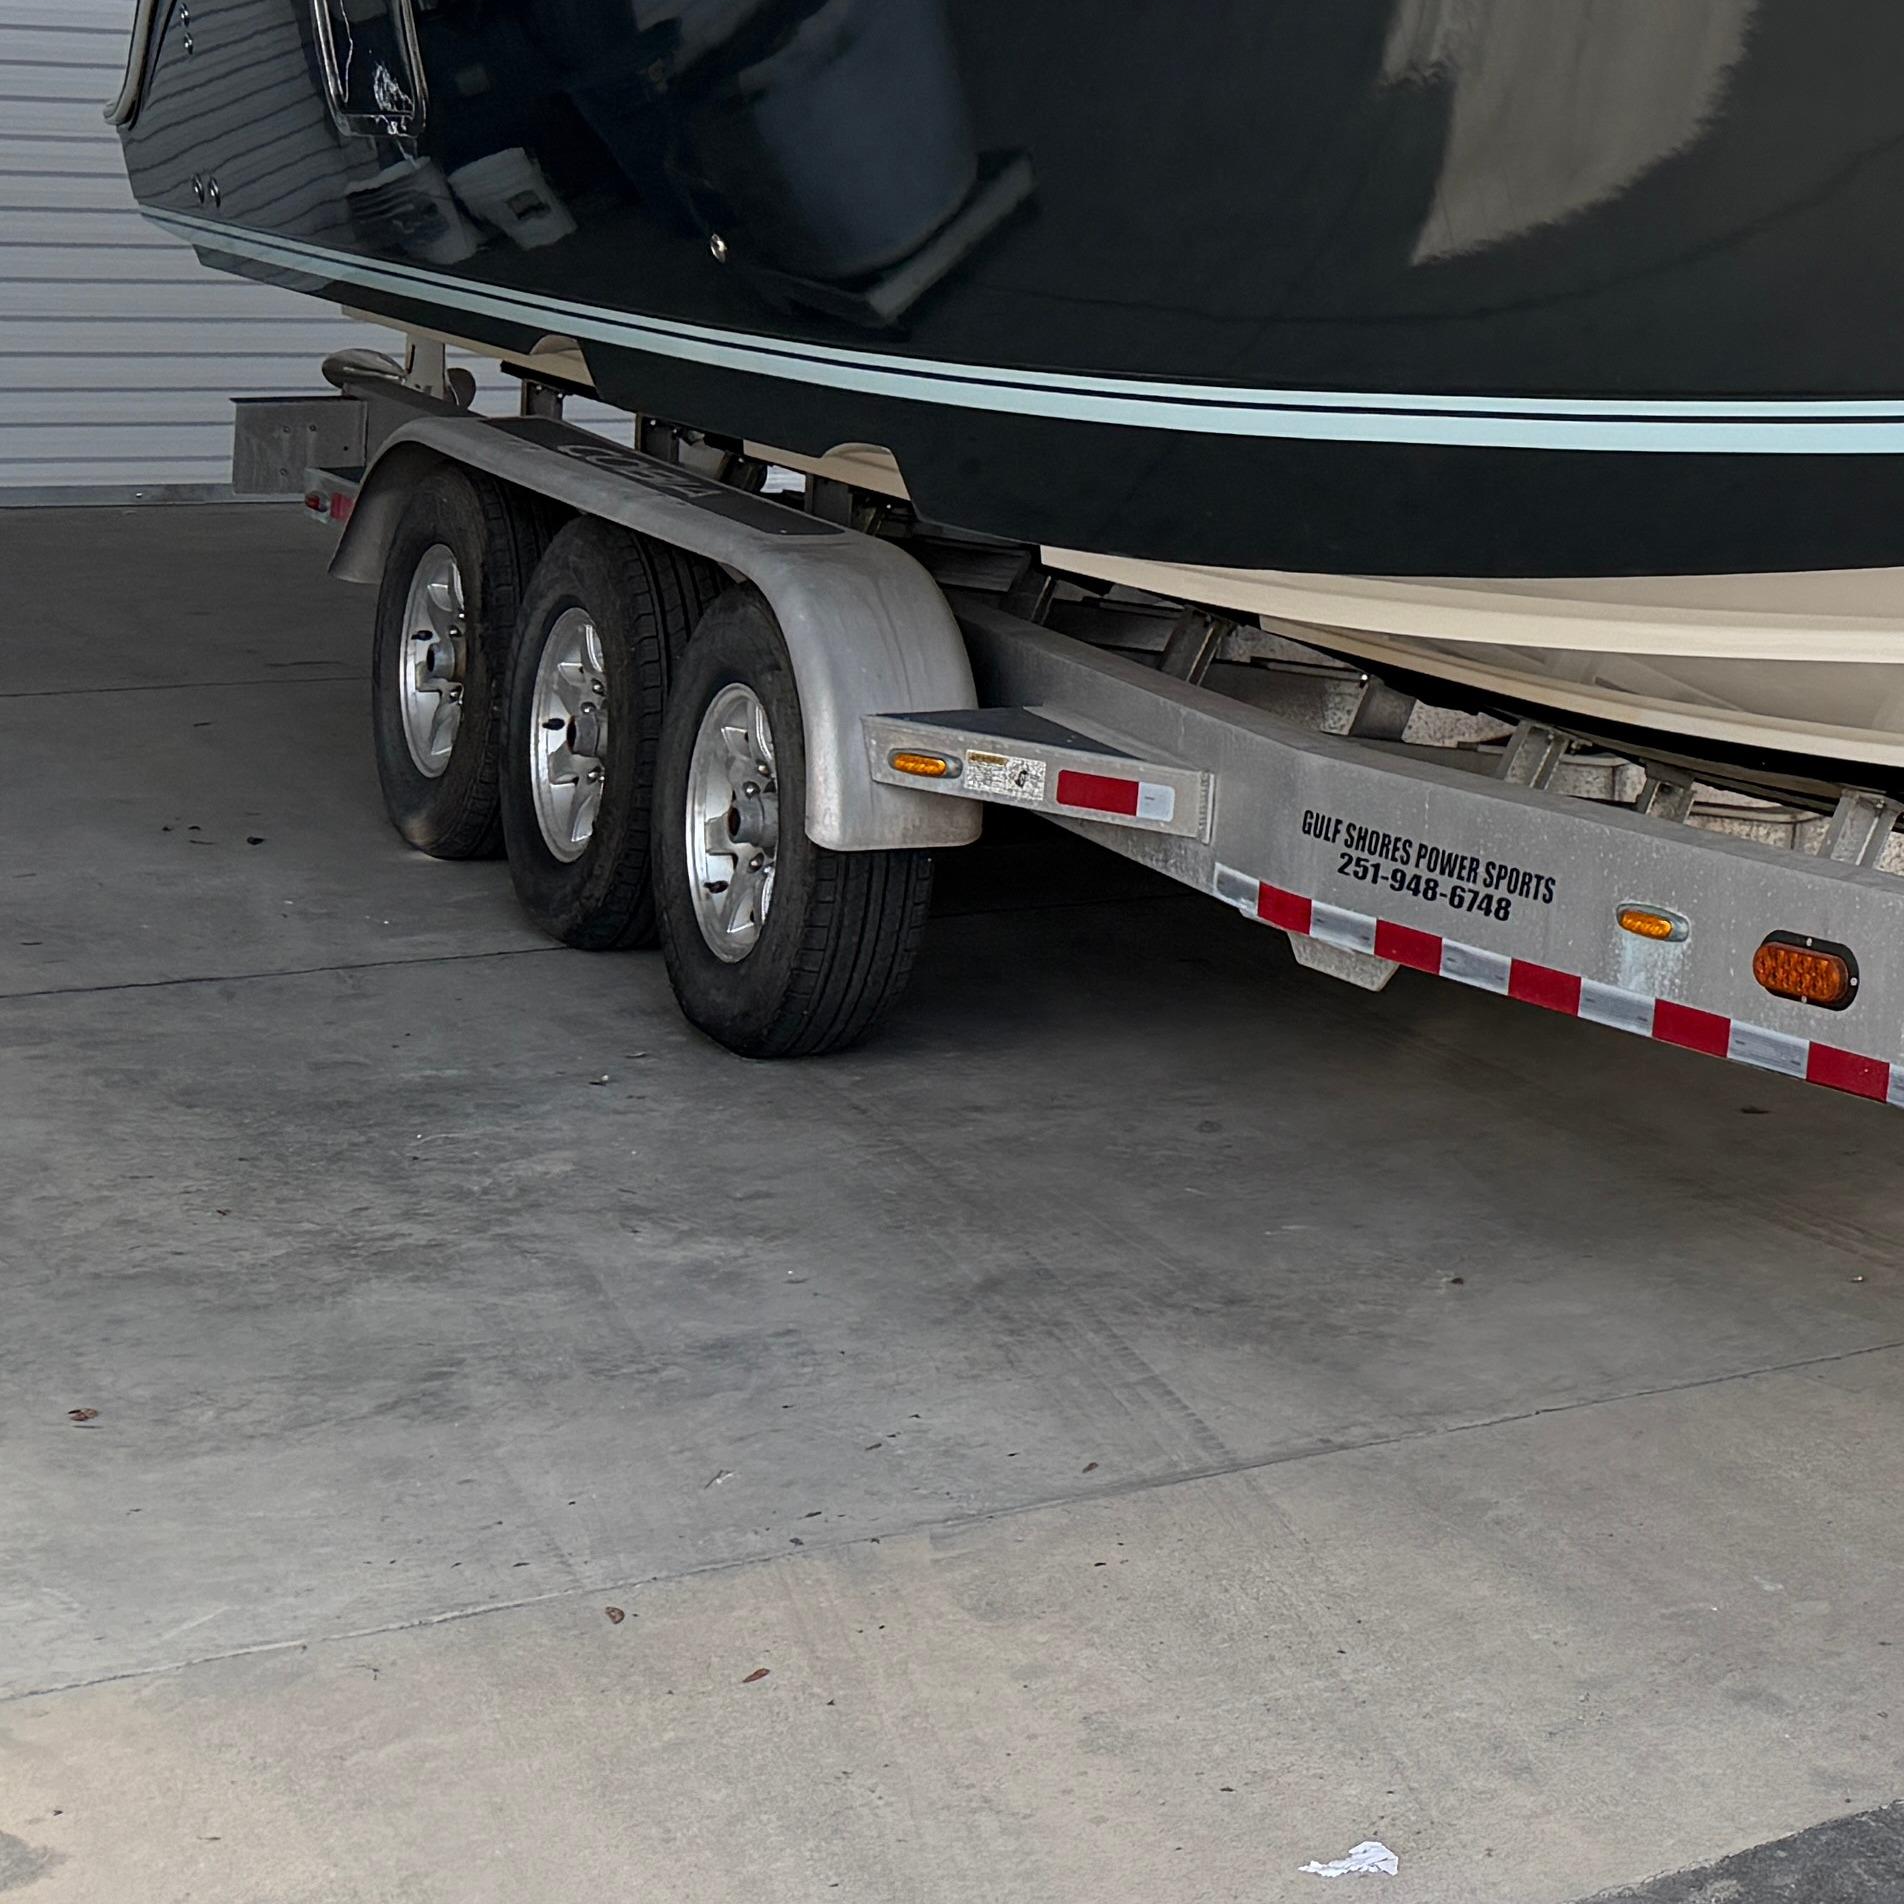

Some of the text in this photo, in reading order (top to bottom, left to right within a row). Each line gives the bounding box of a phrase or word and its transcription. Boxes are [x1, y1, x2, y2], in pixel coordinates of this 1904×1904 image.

[557, 444, 723, 498] COBIA
[1301, 809, 1556, 905] GULF SHORES POWER SPORTS
[1337, 851, 1512, 922] 251-948-6748
